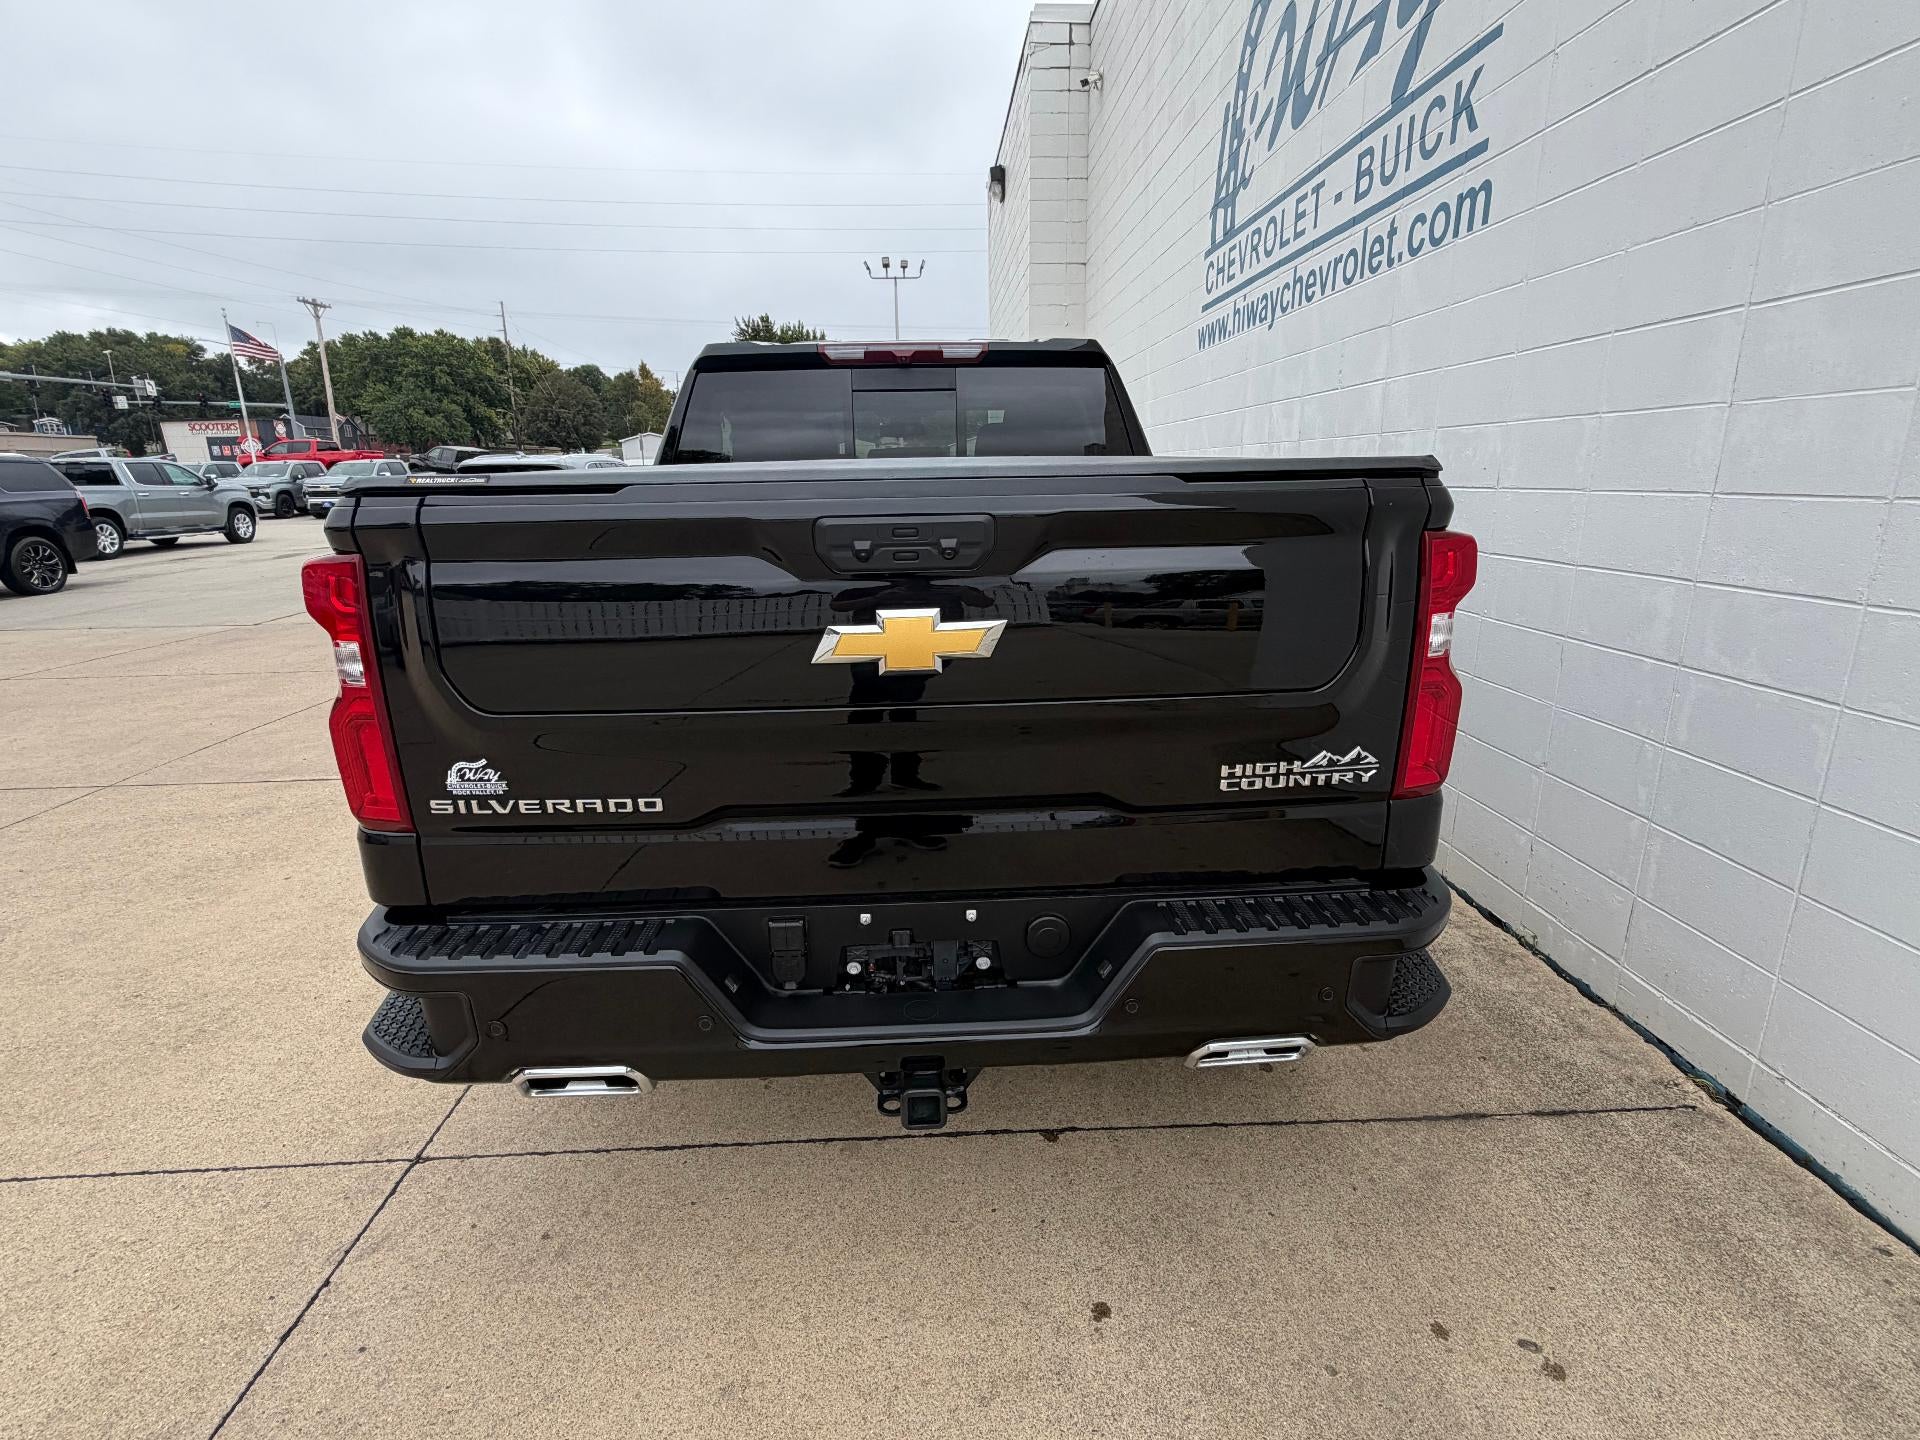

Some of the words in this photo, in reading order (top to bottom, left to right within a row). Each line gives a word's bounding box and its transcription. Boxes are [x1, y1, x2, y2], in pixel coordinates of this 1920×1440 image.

[1204, 179, 1326, 295] CHEVROLET
[1353, 63, 1486, 205] BUICK
[1198, 178, 1494, 351] www.hiwaychevrolet.com
[188, 422, 239, 432] SCOOTER'S
[1220, 760, 1304, 778] HIGH
[1219, 769, 1378, 792] COUNTRY
[429, 798, 664, 815] SILVERADO
